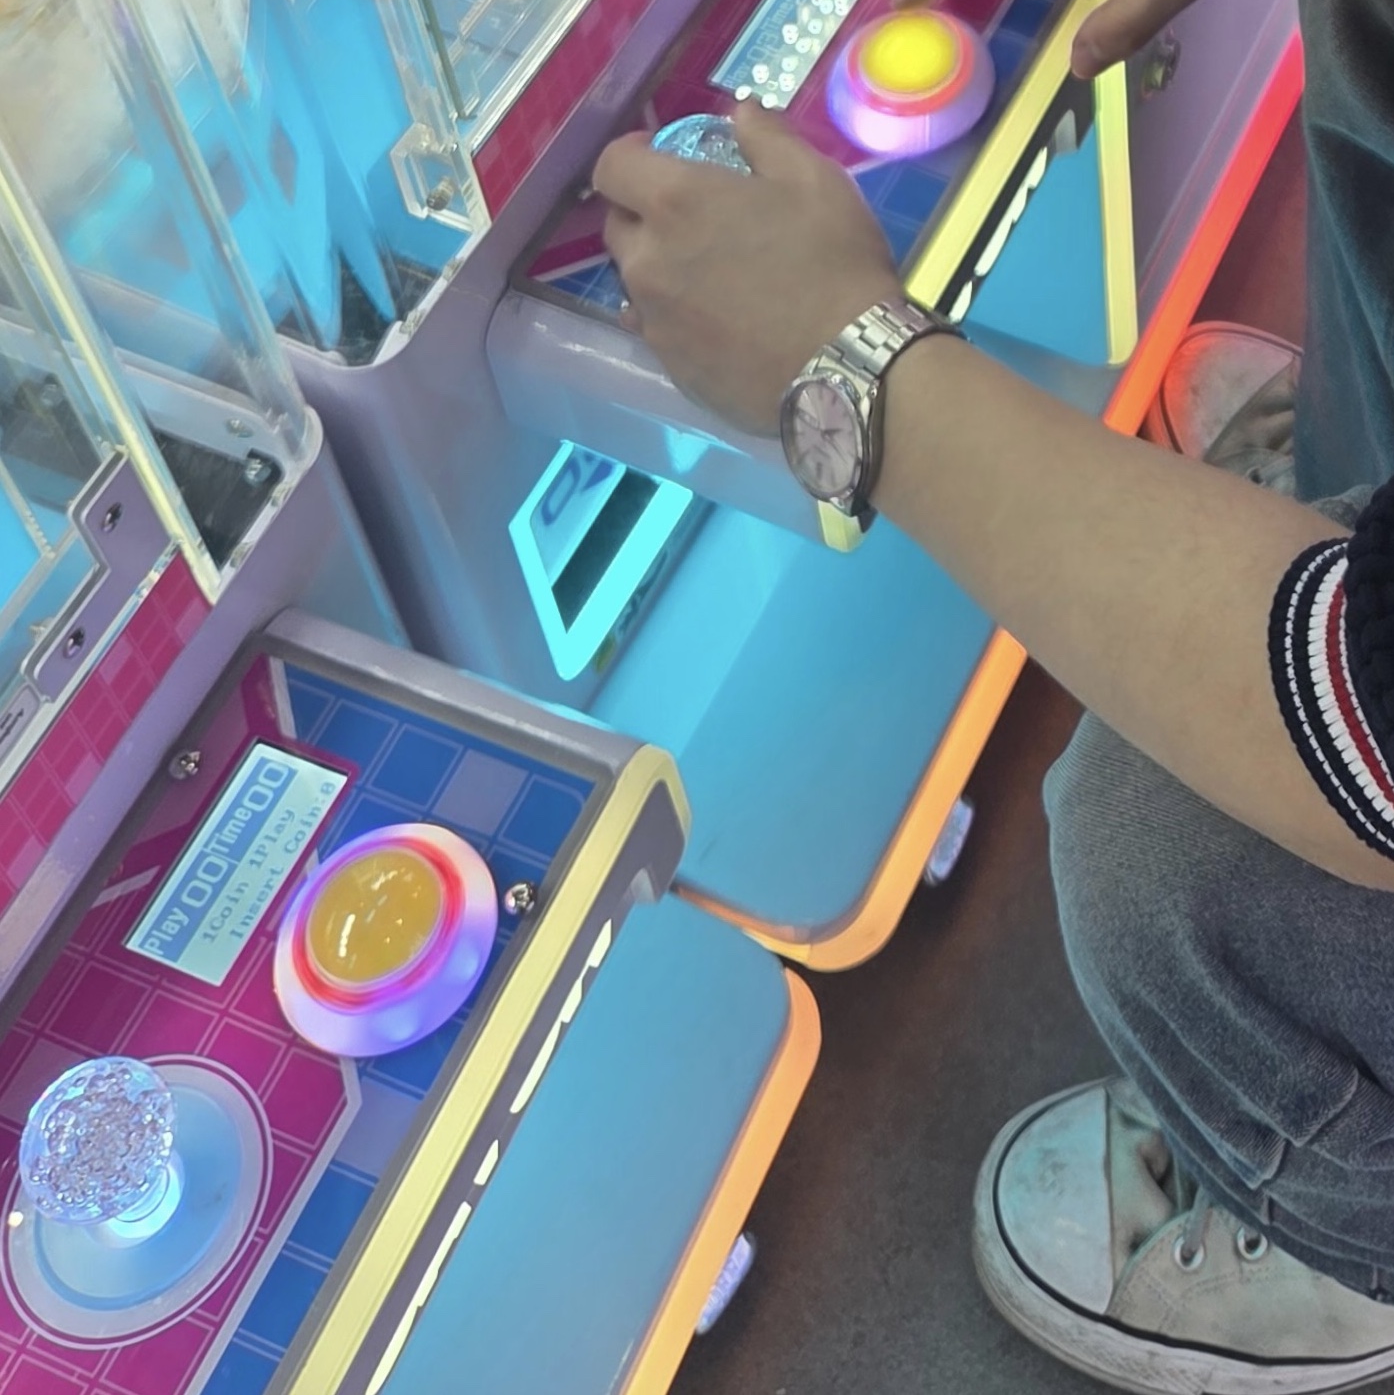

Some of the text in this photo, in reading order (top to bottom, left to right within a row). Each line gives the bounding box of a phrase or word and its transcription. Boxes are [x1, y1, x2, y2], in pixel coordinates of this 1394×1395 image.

[144, 762, 290, 955] Play 00 Time 00
[203, 809, 296, 942] 1Coin 1Play
[230, 867, 284, 938] Insert
